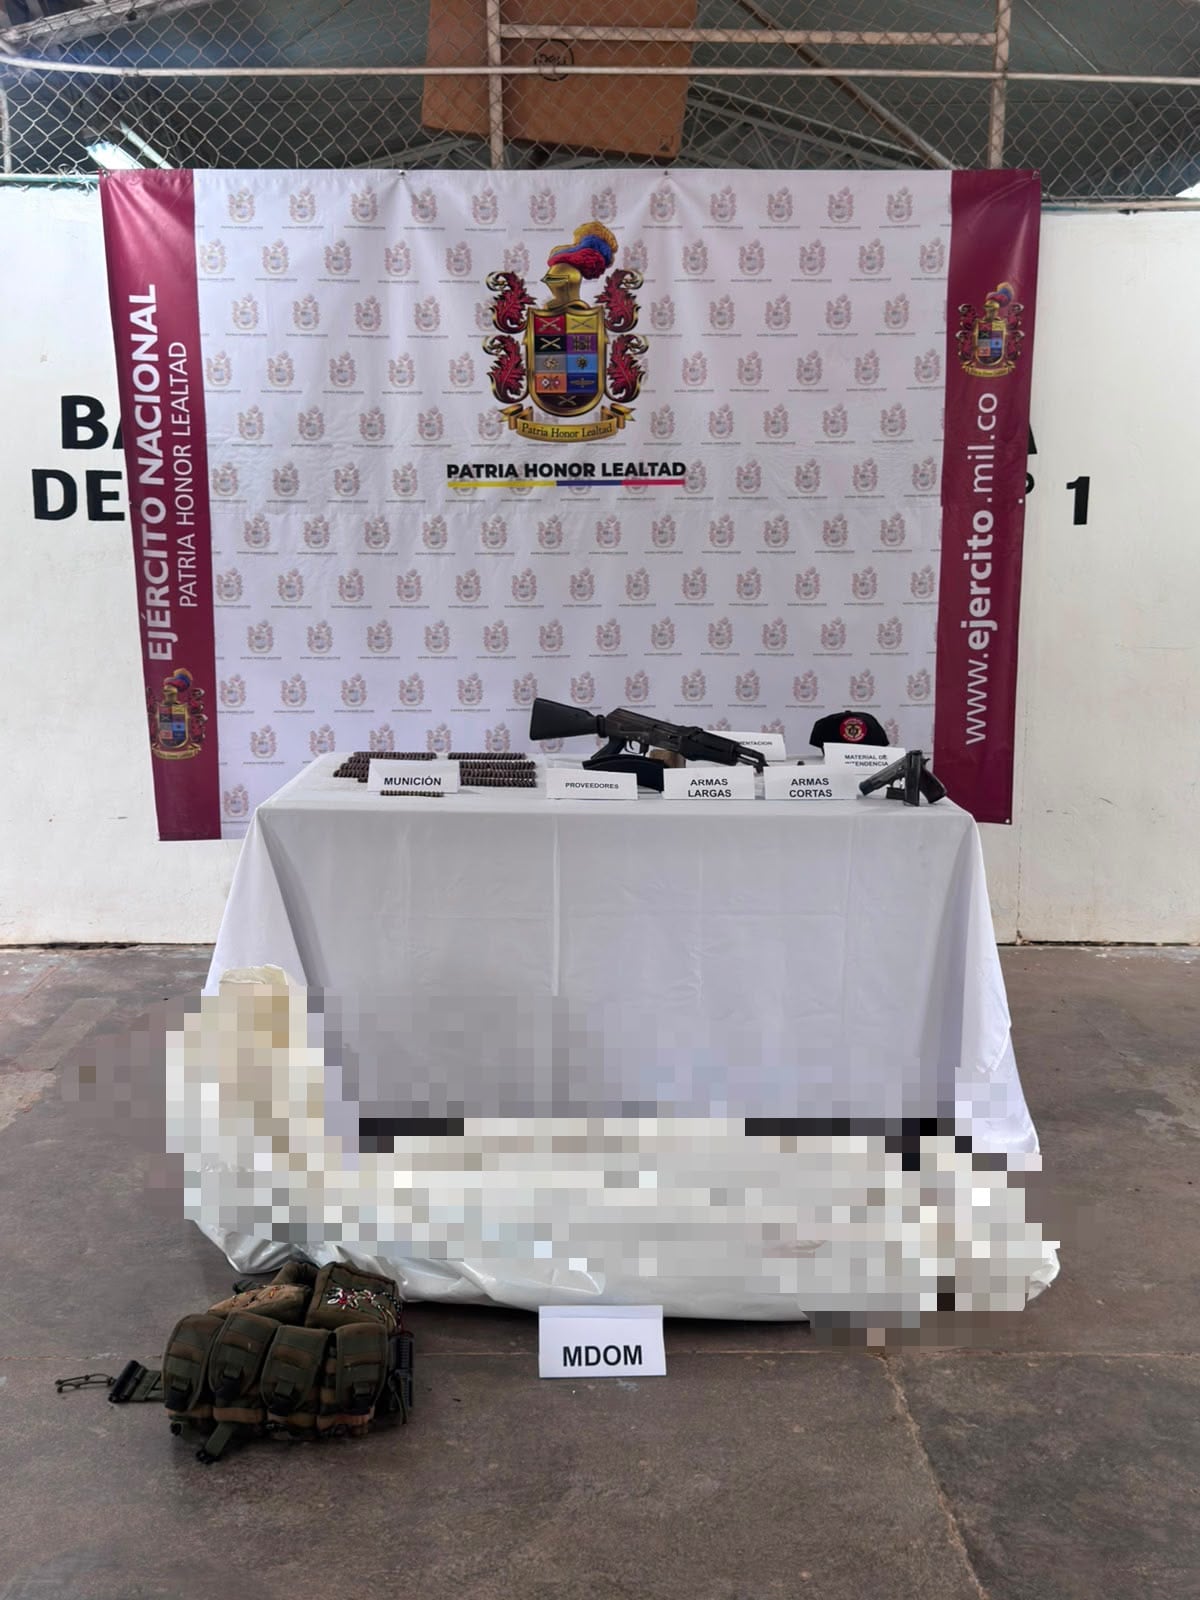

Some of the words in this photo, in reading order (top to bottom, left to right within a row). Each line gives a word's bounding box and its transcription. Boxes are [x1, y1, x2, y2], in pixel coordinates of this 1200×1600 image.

[128, 284, 165, 485] NACIONAL
[168, 341, 191, 436] LEALTAD
[521, 423, 548, 438] Patria
[551, 429, 579, 438] Honor
[582, 423, 613, 437] Lealtad
[446, 463, 519, 479] PATRIA
[524, 463, 595, 478] HONOR
[602, 462, 686, 477] LEALTAD
[32, 469, 125, 521] DE
[173, 444, 195, 526] HONOR
[1066, 476, 1090, 525] 1
[140, 496, 178, 661] EJÉRCITO
[178, 533, 198, 608] PATRIA
[960, 392, 998, 745] www.ejercito.mil.co
[383, 774, 442, 787] MUNICIÓN
[565, 782, 619, 790] PROVEEDORES
[690, 778, 728, 786] ARMAS
[791, 778, 829, 786] ARMAS
[688, 789, 732, 798] LARGAS
[789, 789, 833, 798] CORTAS
[562, 1344, 643, 1367] MDOM
